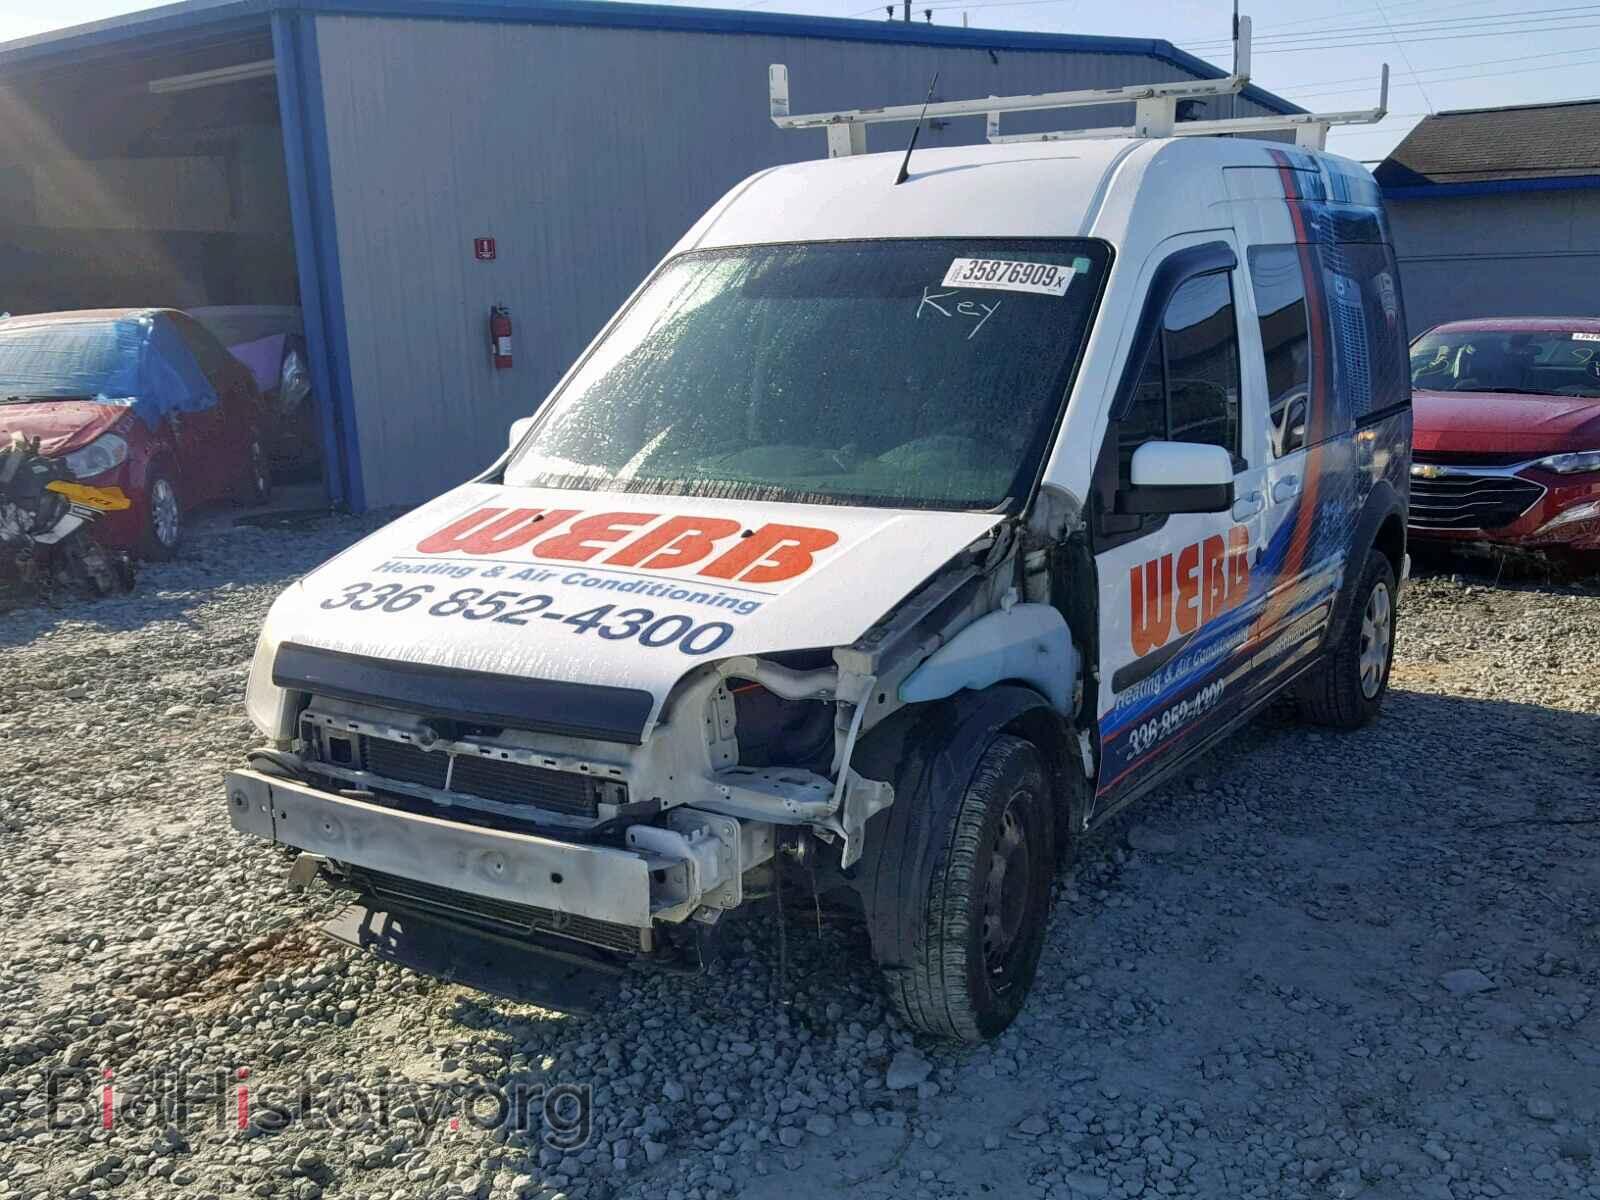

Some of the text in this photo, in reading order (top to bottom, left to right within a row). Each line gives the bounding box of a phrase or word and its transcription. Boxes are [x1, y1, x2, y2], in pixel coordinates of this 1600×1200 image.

[916, 287, 1001, 339] Key
[417, 507, 838, 583] WEBB
[320, 582, 734, 655] 336 852-4300
[372, 561, 763, 615] Heating & Air Conditioning
